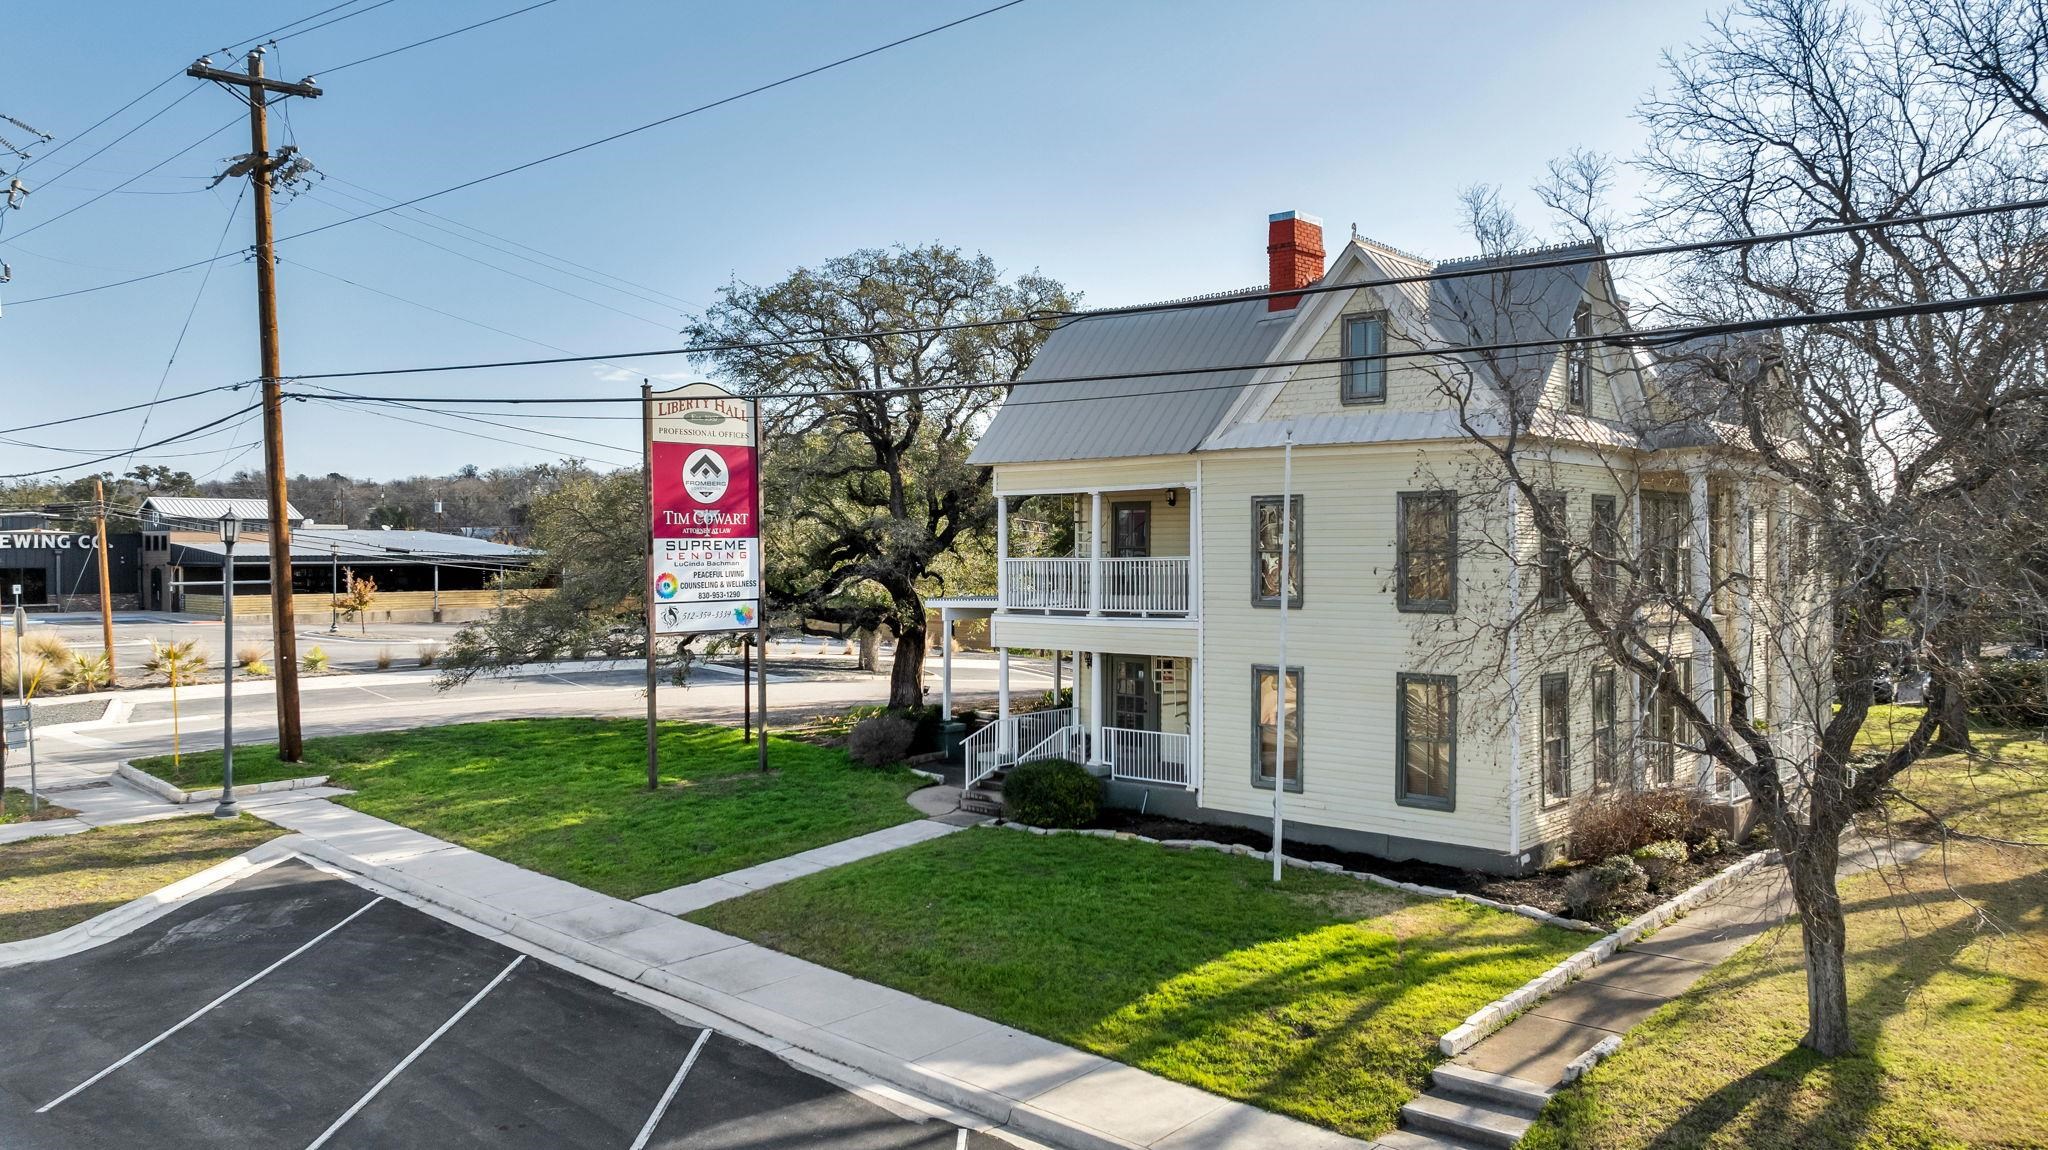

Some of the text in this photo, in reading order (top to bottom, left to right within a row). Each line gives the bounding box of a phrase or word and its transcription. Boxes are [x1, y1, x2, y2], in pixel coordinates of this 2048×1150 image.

[715, 399, 748, 422] HALL
[659, 427, 749, 438] PROFESSIONAL OFFICES
[663, 510, 749, 525] TIM COWART
[0, 534, 71, 548] EWING
[666, 540, 747, 550] SUPREME
[666, 552, 747, 560] LENDING
[693, 570, 744, 579] PEACEFUL LIVING
[680, 581, 718, 589] COUNSELING
[726, 580, 757, 588] WELLNESS
[698, 591, 741, 599] 830-953-1290
